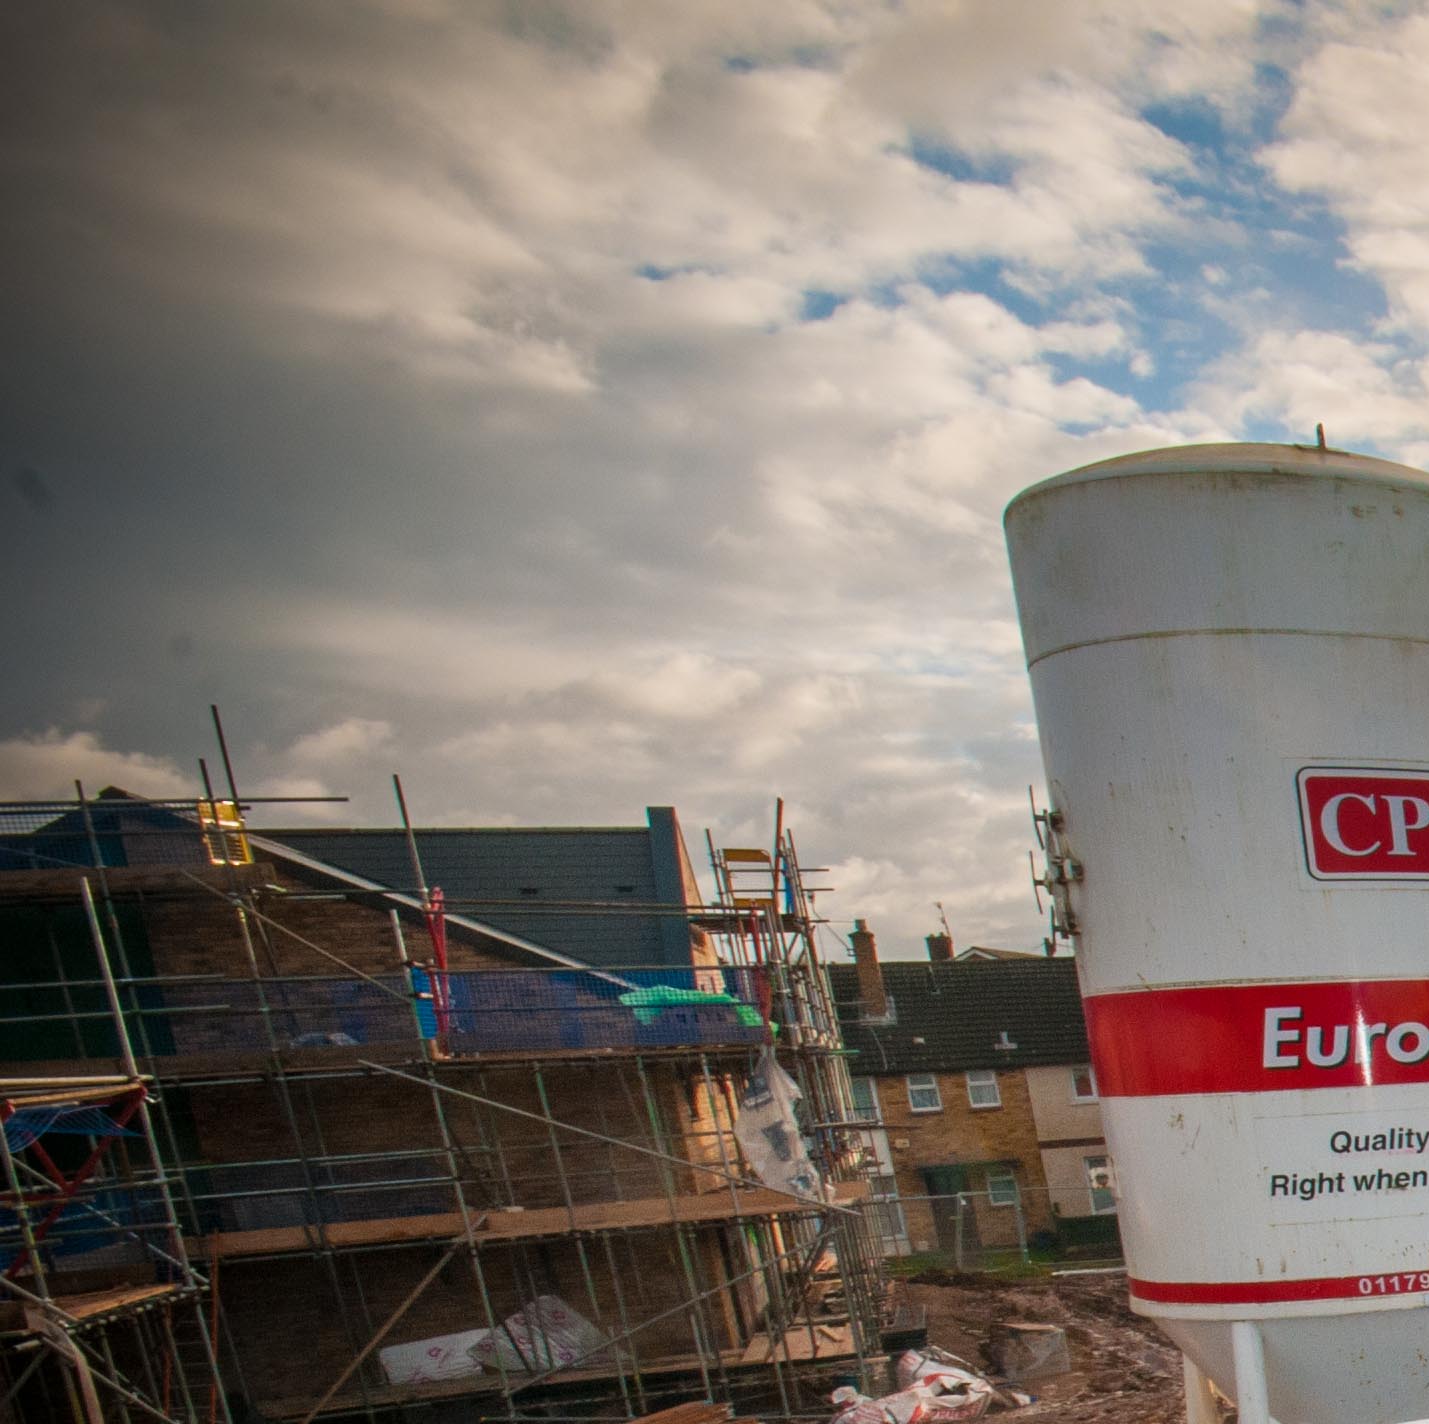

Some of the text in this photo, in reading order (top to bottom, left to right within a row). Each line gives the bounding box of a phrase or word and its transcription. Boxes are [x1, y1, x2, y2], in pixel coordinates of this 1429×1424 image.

[1330, 1126, 1429, 1154] Quality
[1270, 1173, 1345, 1202] Right
[1352, 1166, 1428, 1192] when
